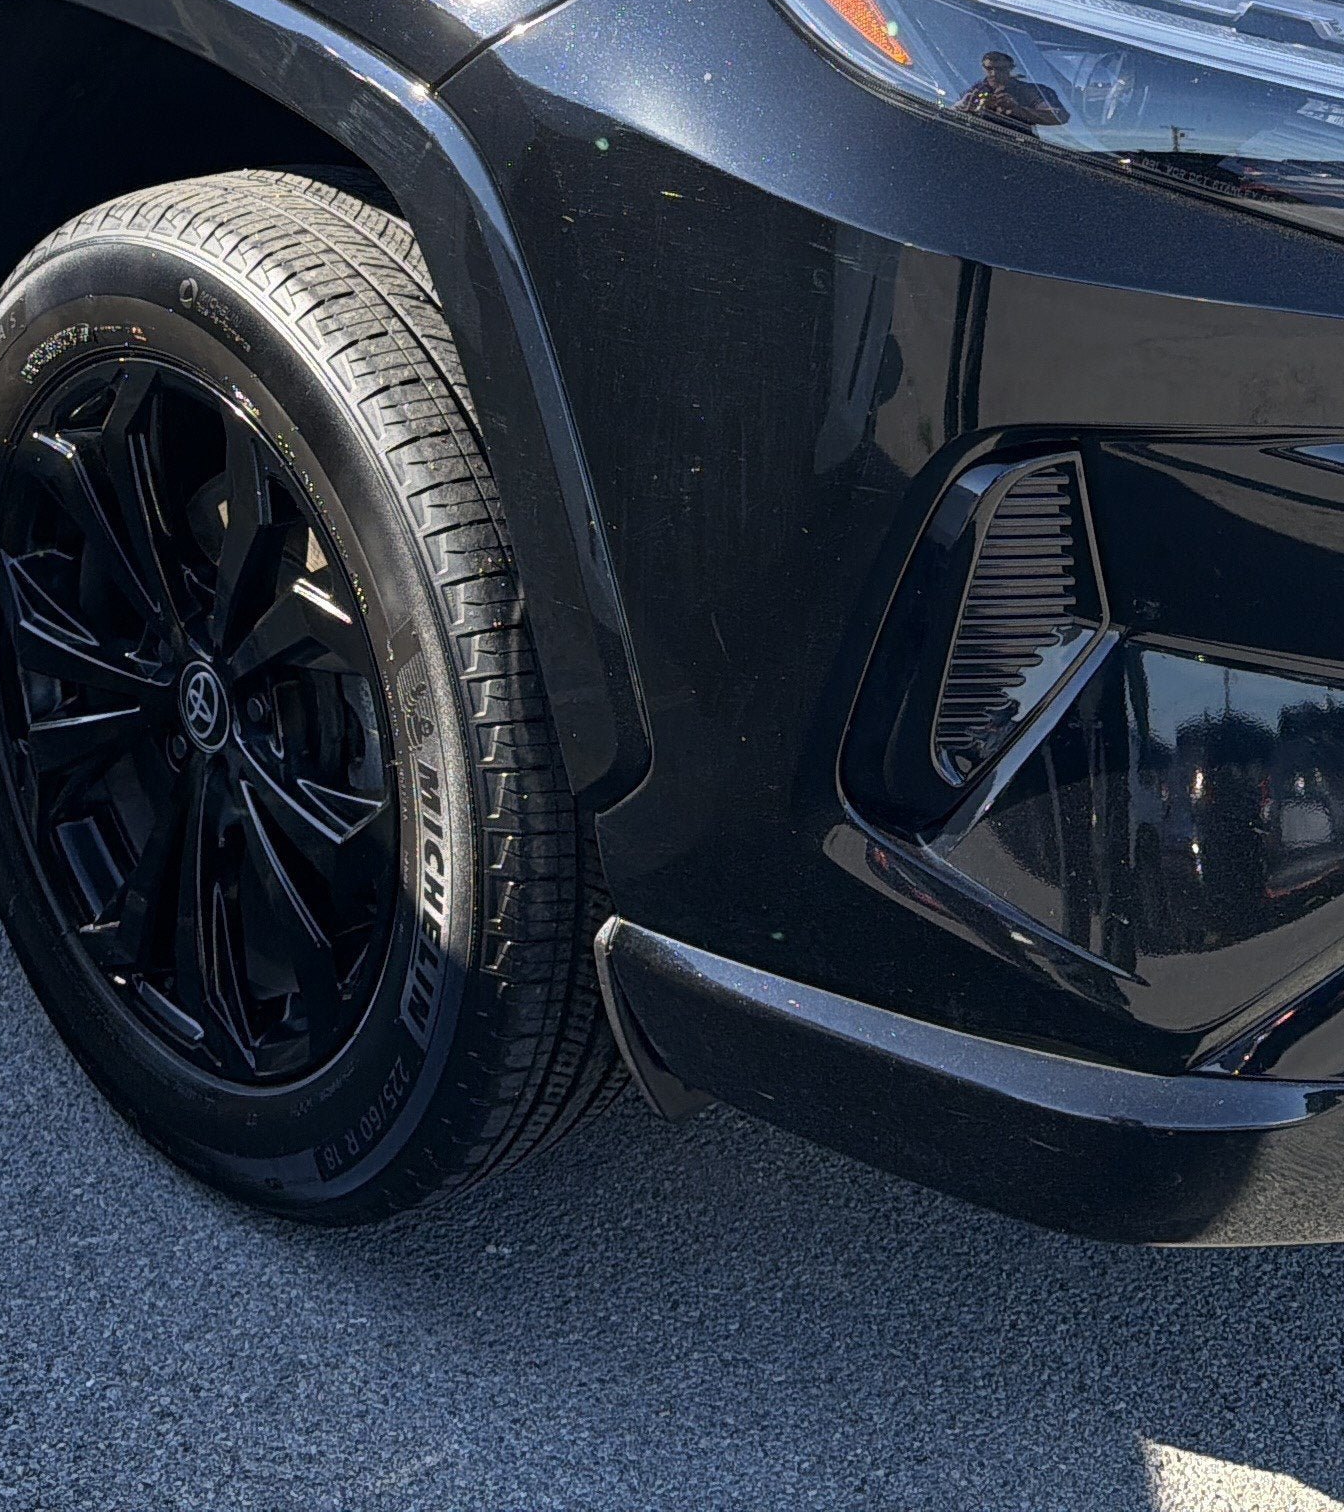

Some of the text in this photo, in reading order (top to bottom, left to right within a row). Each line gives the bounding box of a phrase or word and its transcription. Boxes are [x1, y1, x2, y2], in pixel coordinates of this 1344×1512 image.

[408, 758, 446, 1035] MICHELIN
[322, 1055, 410, 1171] 225/60 R 18
